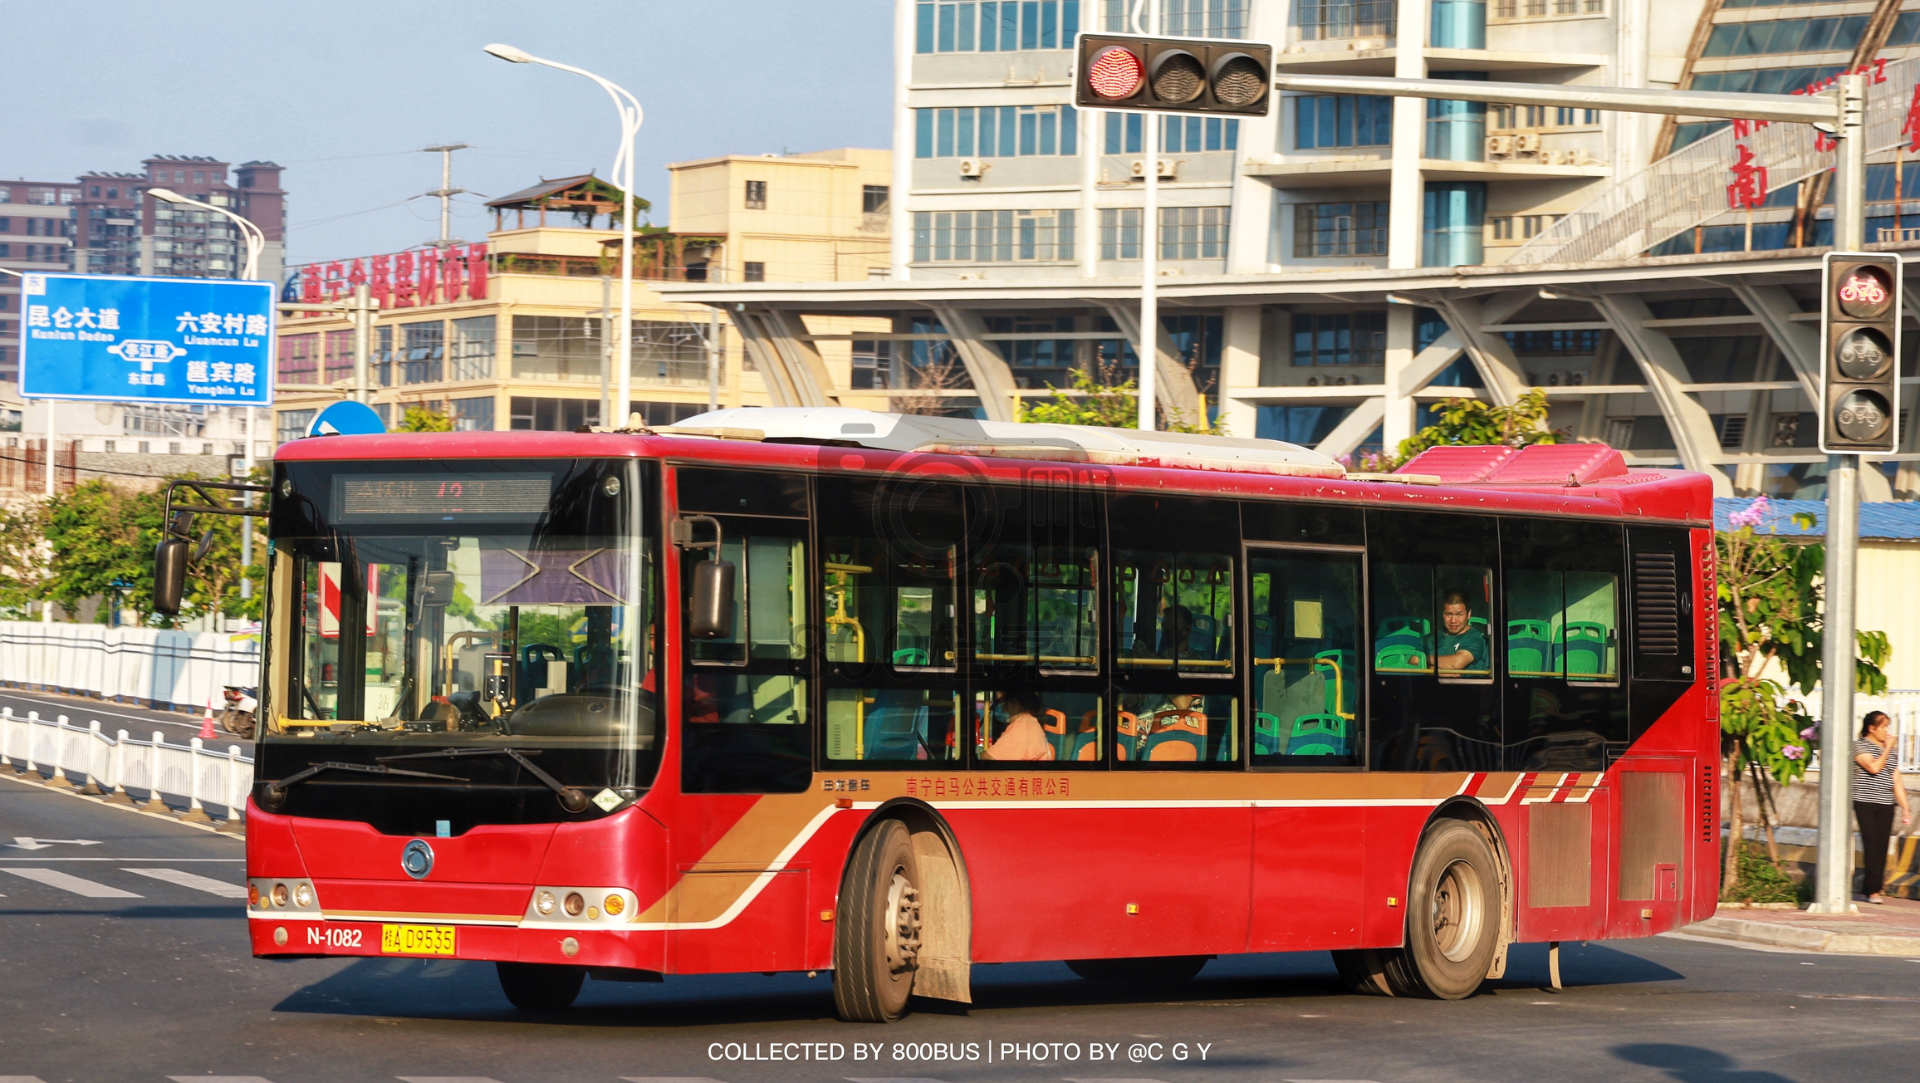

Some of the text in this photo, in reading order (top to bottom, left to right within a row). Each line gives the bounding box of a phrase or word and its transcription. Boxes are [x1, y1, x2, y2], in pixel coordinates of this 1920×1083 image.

[28, 305, 120, 330] 昆仑大道
[176, 312, 268, 336] 六安村路
[32, 329, 114, 342] Kunlun Dadao
[184, 335, 259, 347] Liuancun Lu
[187, 361, 256, 385] 邕宾路
[187, 384, 255, 397] Yongbin Lu
[906, 777, 1070, 797] 南宁白马公共交通有限公司
[598, 796, 616, 804] LNG
[307, 927, 362, 947] N-1082
